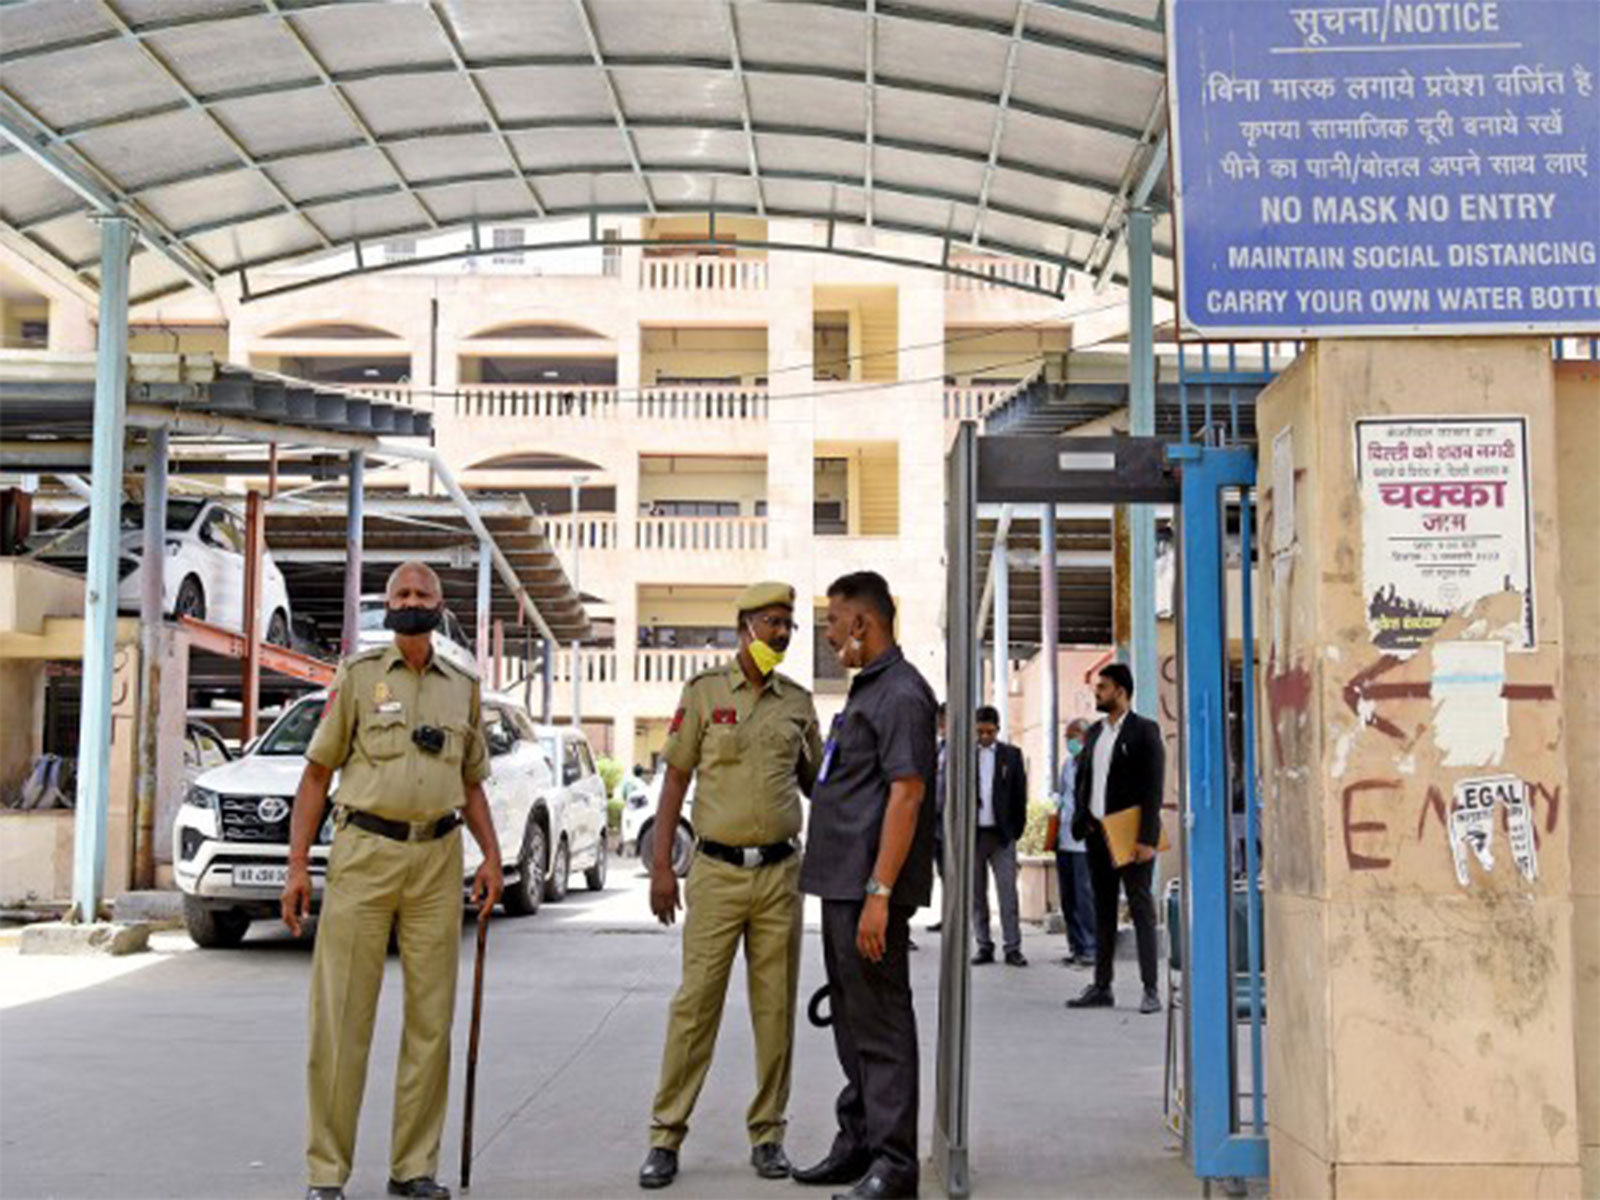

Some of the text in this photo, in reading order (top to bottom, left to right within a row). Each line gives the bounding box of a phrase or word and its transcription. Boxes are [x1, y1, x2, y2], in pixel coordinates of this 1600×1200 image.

[1208, 63, 1593, 102] बिना मास्क लगाये प्रवेश वर्जित है
[1239, 108, 1563, 147] कृपया सामाजिक दूरी बनाये रखें
[1219, 151, 1260, 180] पीने
[1267, 158, 1298, 179] का
[1429, 149, 1482, 177] अपने
[1488, 153, 1536, 175] साथ
[1543, 146, 1588, 177] लाएं
[1261, 193, 1557, 224] NO MASK NO ENTRY
[1228, 242, 1597, 269] MAINTAIN SOCIAL DISTANCING
[1206, 289, 1288, 314] CARRY
[1294, 289, 1363, 313] YOUR
[1370, 288, 1430, 312] OWN
[1436, 286, 1520, 311] WATER
[1412, 442, 1433, 460] को
[1378, 480, 1508, 508] चक्का
